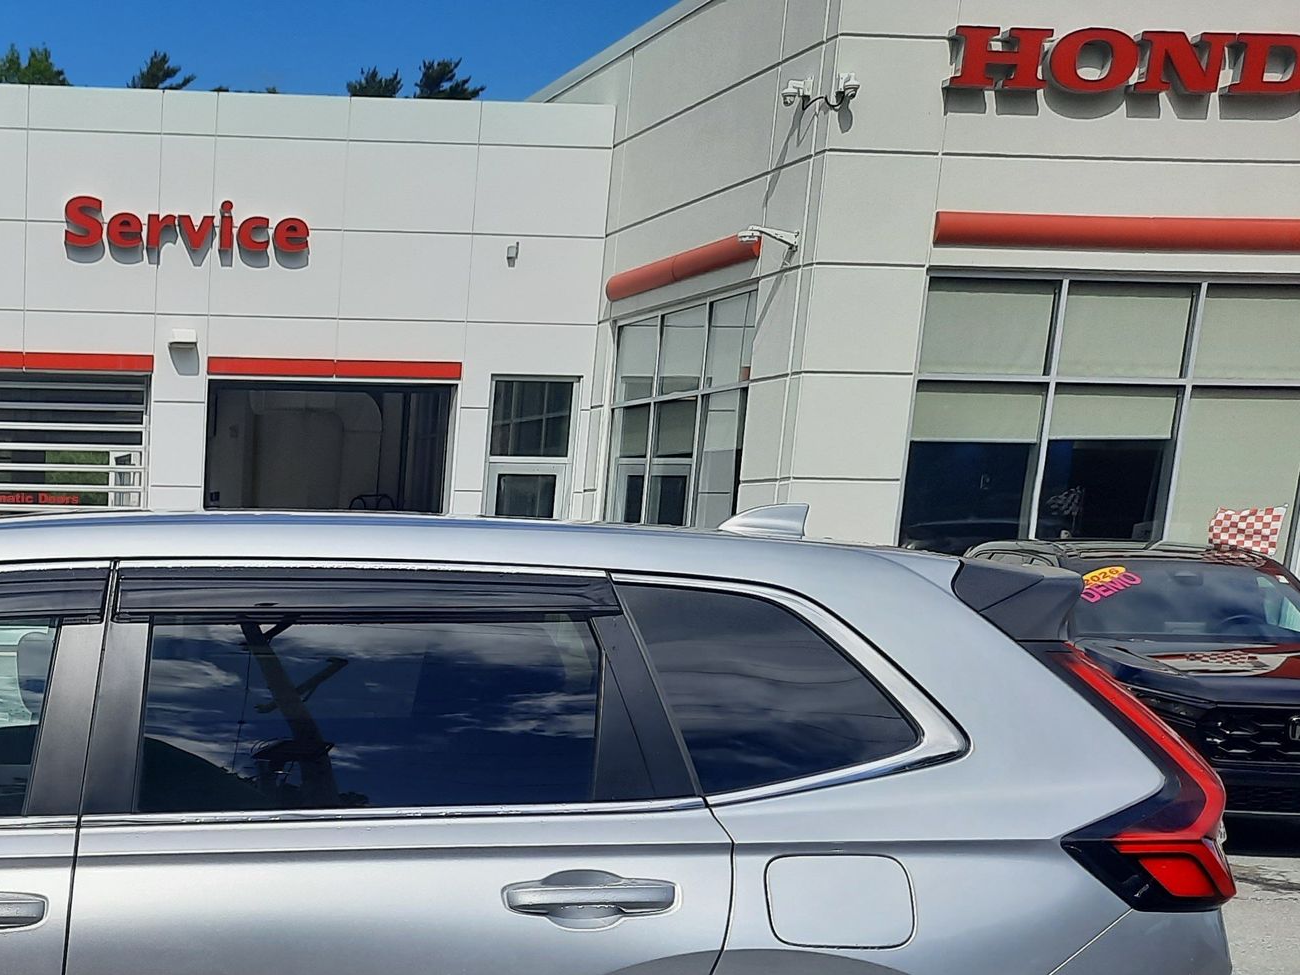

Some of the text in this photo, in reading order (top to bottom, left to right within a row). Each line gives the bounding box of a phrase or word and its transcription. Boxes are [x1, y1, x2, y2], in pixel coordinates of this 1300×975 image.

[946, 25, 1300, 98] HOND
[64, 196, 311, 256] Service
[38, 493, 79, 504] Doors
[1080, 572, 1141, 602] DEMO
